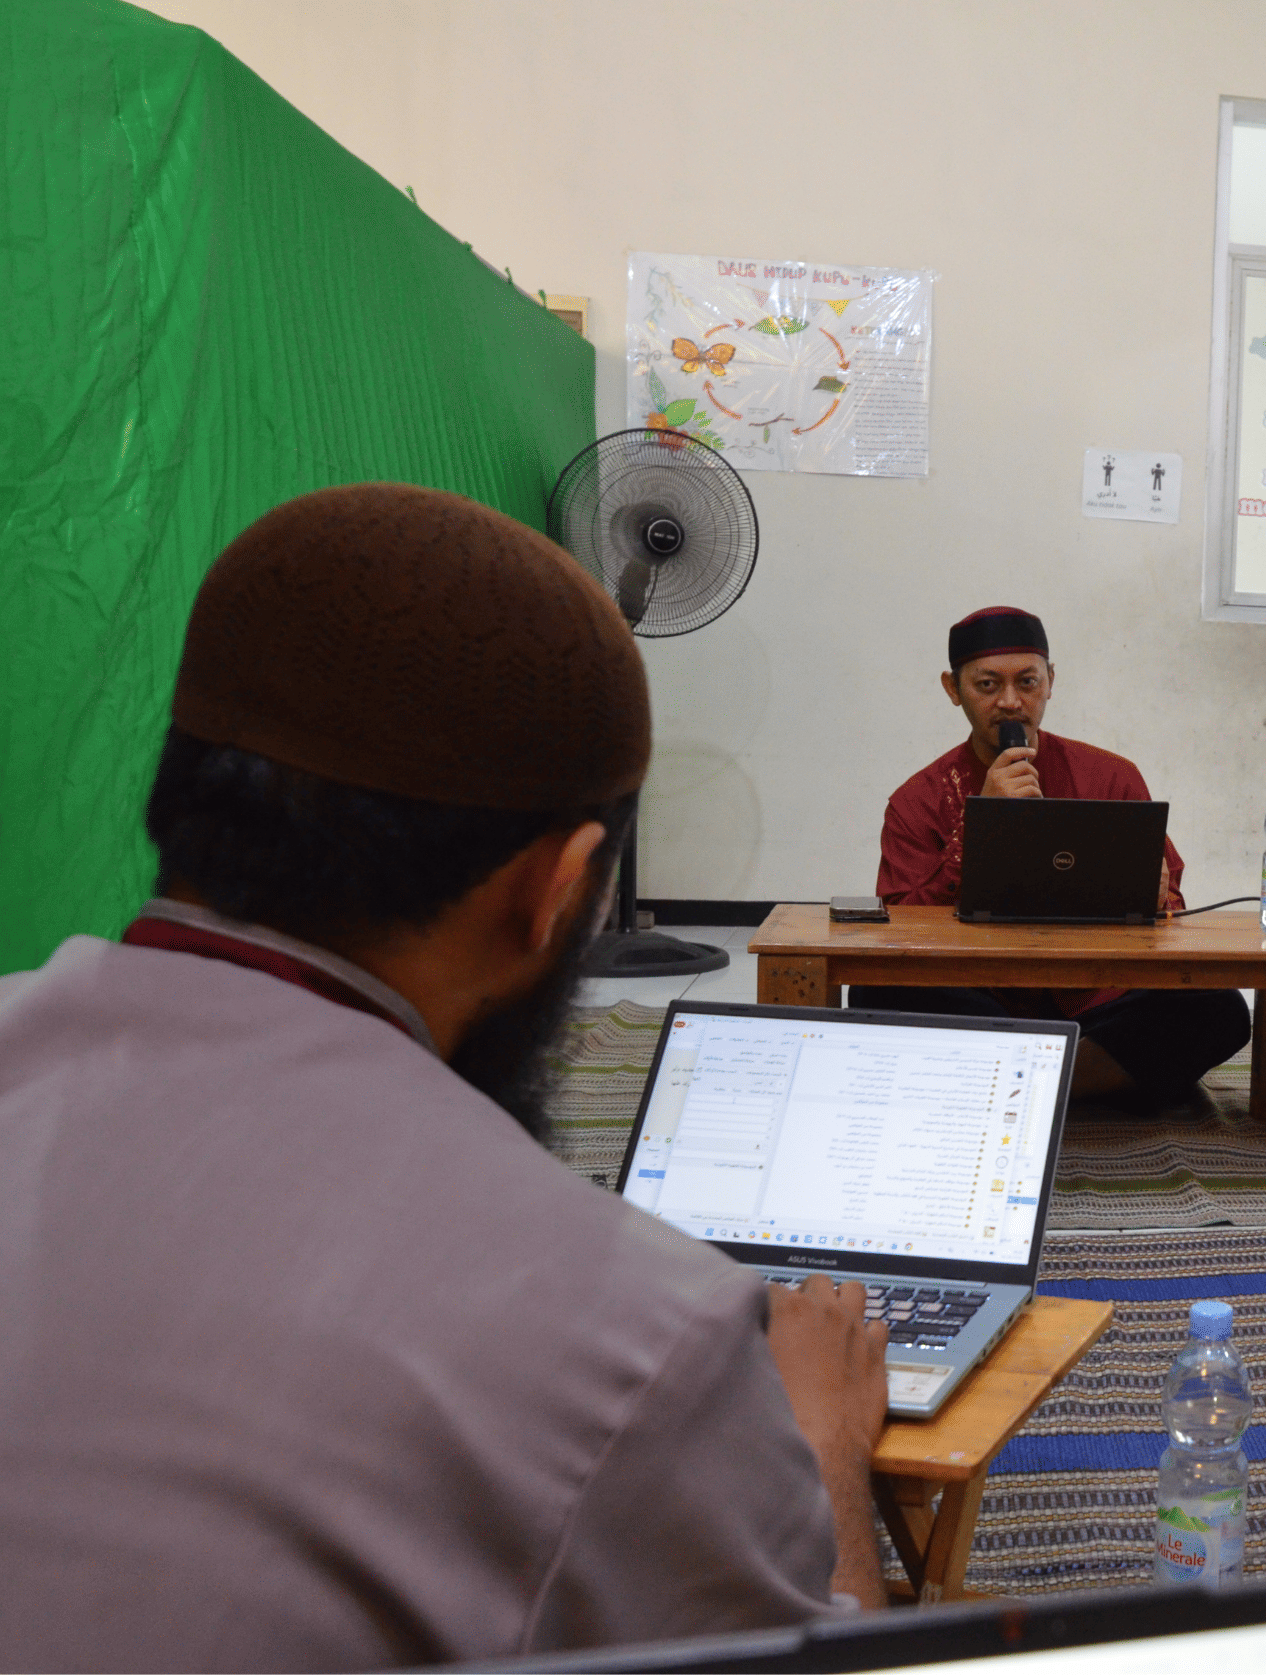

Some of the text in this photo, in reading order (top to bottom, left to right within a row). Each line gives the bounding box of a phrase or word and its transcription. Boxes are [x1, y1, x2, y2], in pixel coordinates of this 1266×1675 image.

[787, 1255, 807, 1264] ASUS
[1168, 1533, 1183, 1552] Le
[1156, 1539, 1206, 1567] Minerale
